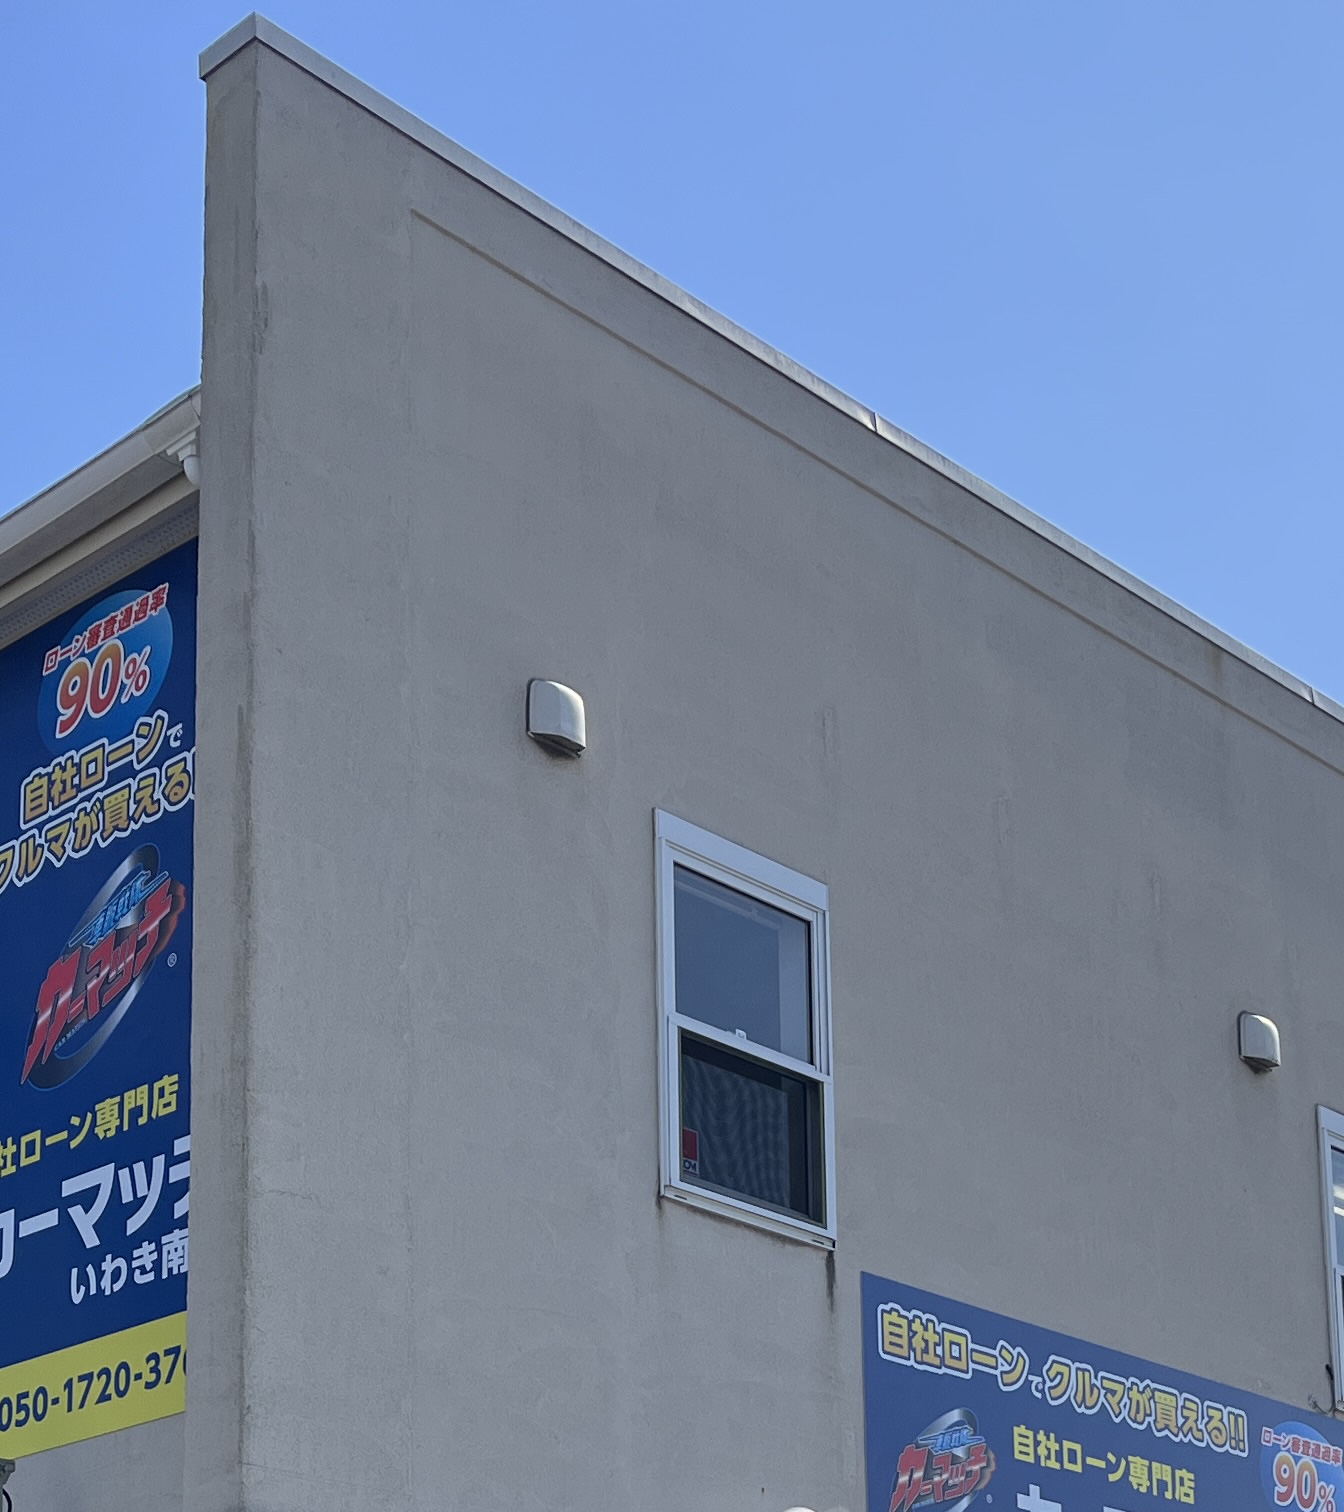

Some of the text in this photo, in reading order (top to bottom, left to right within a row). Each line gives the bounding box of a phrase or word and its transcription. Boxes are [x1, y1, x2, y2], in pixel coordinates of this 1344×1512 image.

[55, 639, 151, 738] 90%
[20, 710, 183, 829] 自社ローンで
[1012, 1424, 1196, 1504] 自社ローン専門店
